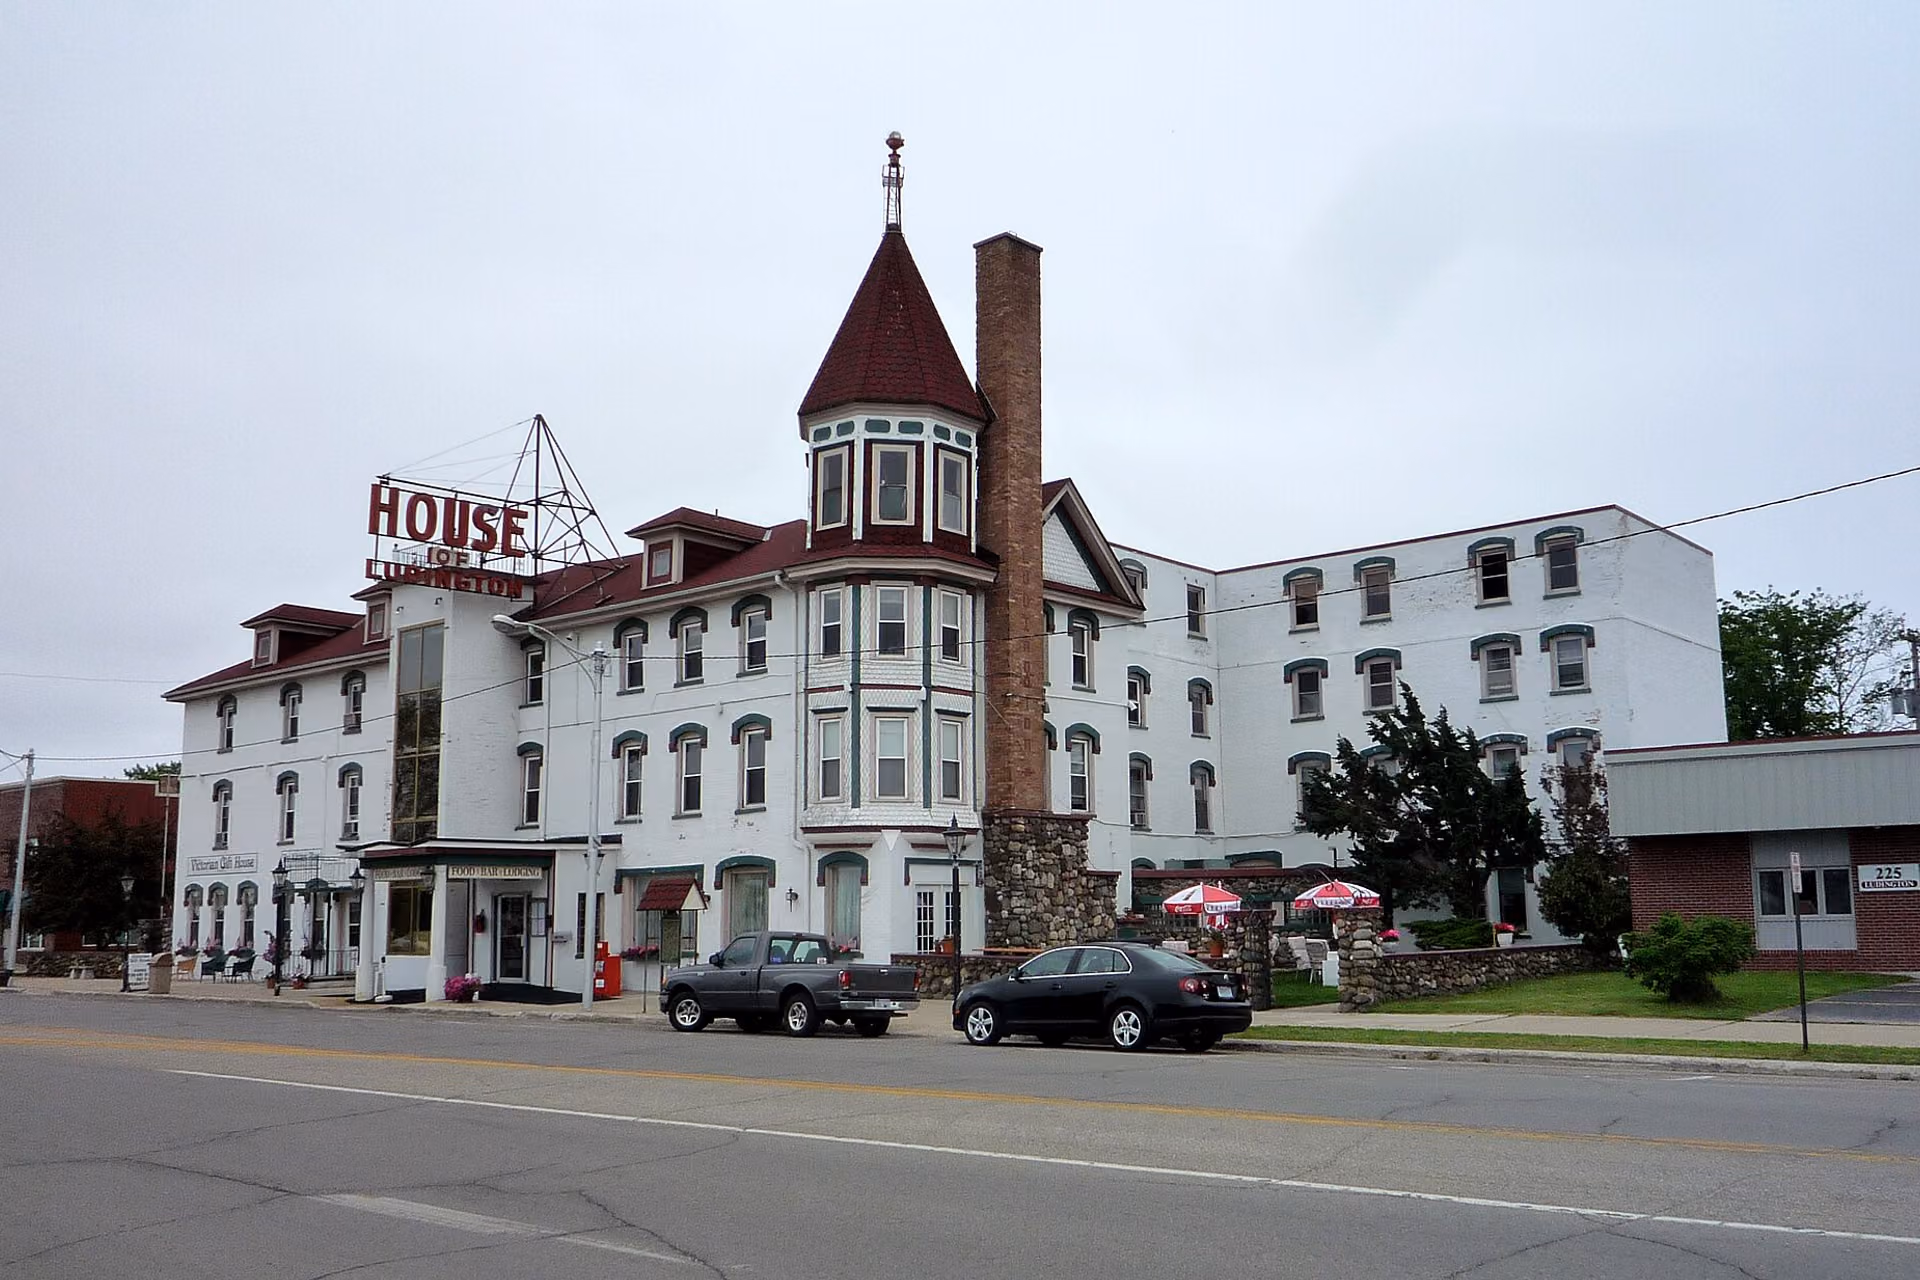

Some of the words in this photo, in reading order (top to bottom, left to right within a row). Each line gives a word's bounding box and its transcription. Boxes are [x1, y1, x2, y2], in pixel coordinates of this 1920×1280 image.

[368, 484, 528, 558] HOUSE
[436, 548, 470, 567] OF
[365, 558, 524, 599] LUDINGTON
[190, 859, 218, 871] Victorian
[234, 855, 255, 868] House
[451, 866, 476, 877] FOOD
[480, 867, 498, 877] BAR
[503, 867, 540, 877] LODGING
[1875, 867, 1902, 879] 225
[1864, 880, 1915, 888] LUDINGTON
